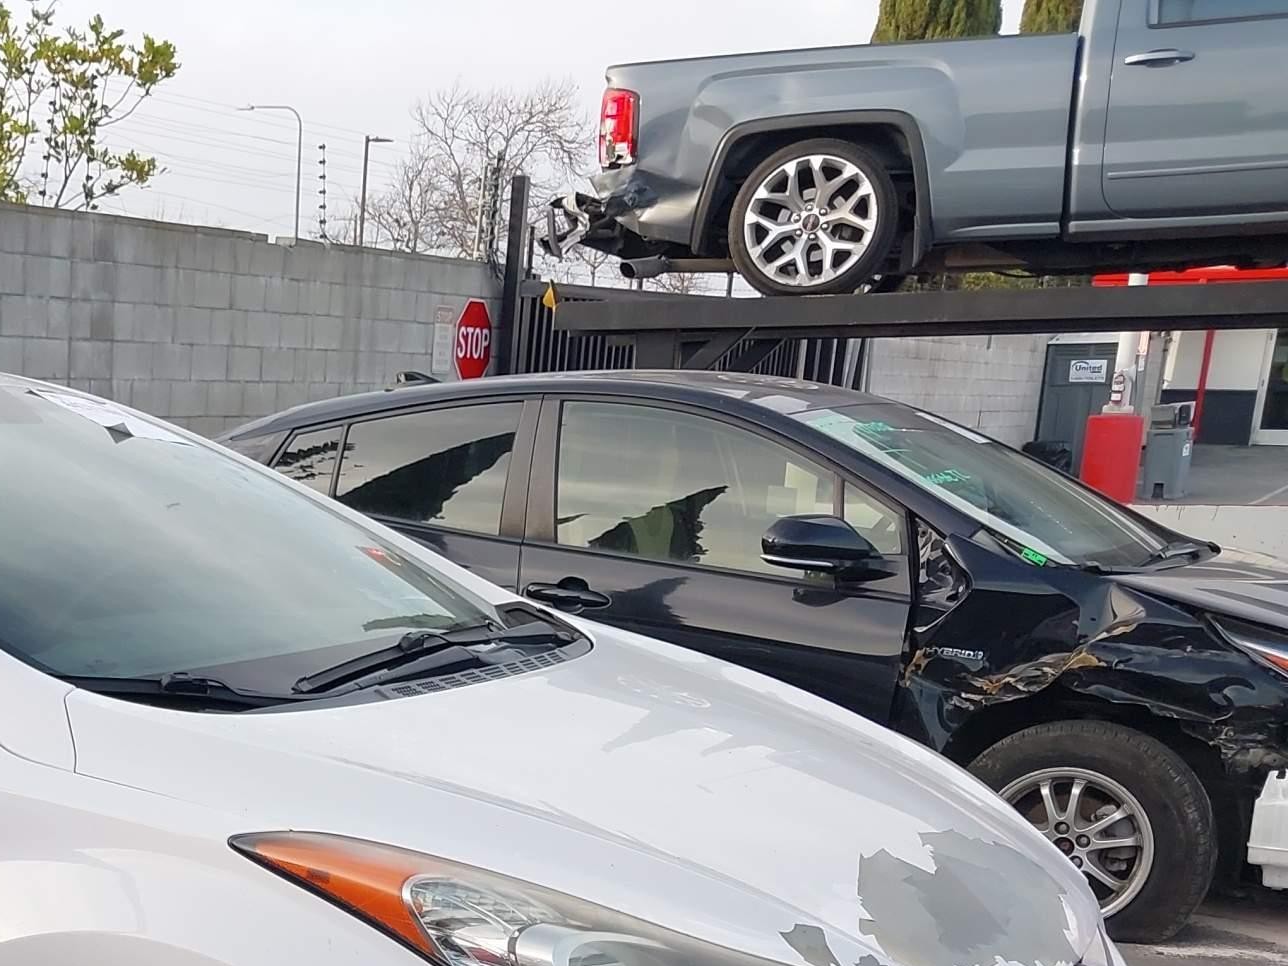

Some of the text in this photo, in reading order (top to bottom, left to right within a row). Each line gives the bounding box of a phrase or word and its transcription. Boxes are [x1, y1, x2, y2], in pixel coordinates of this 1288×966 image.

[457, 326, 489, 359] STOP
[1074, 364, 1103, 373] United
[923, 647, 974, 659] HYBRID
